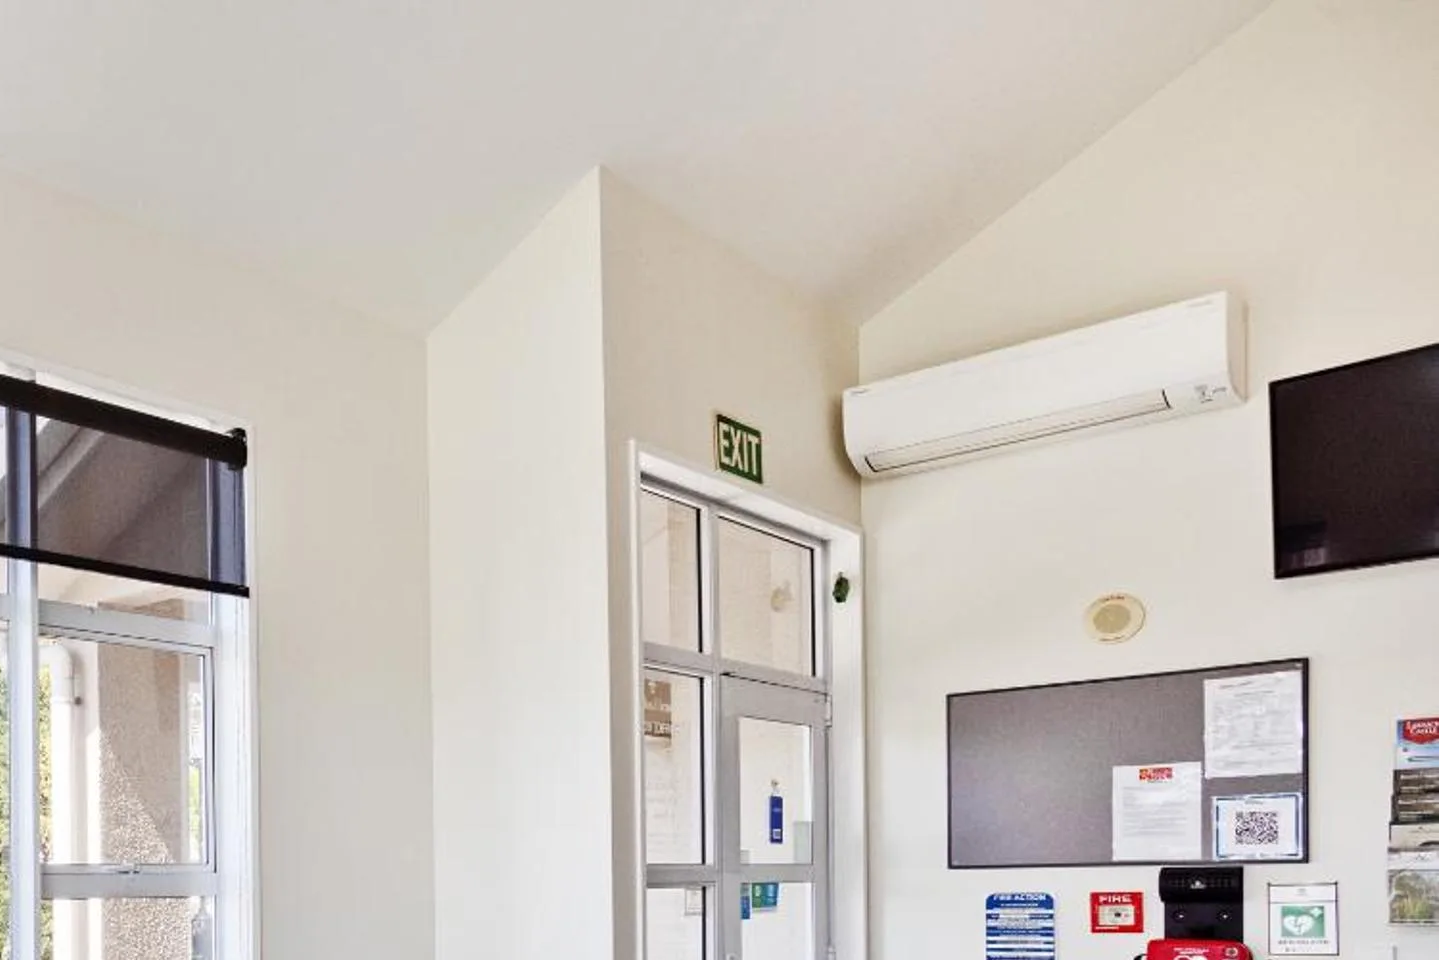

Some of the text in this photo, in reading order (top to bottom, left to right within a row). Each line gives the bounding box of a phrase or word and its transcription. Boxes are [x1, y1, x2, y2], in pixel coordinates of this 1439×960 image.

[719, 421, 760, 476] EXIT
[1014, 893, 1046, 901] ACTION
[1098, 895, 1131, 903] FIRE
